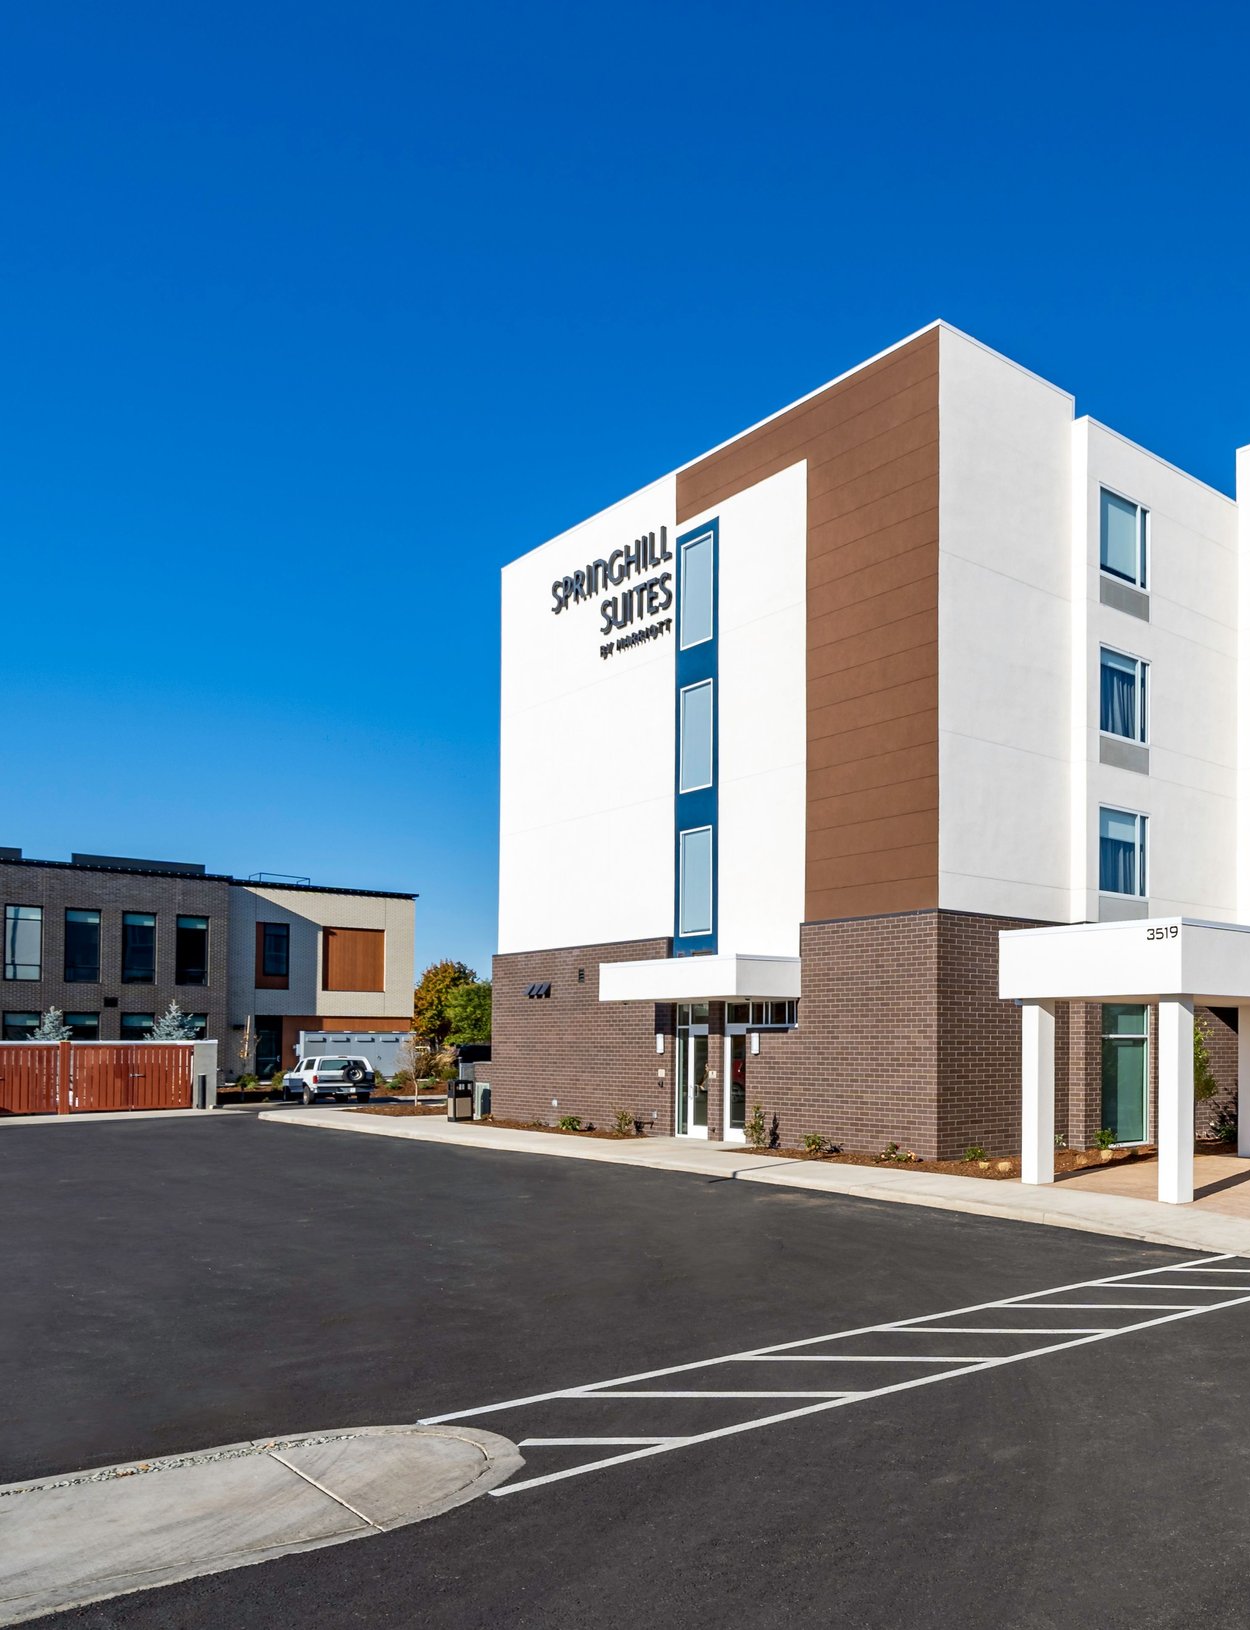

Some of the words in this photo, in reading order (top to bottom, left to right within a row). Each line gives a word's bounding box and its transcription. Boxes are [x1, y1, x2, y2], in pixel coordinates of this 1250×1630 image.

[551, 525, 673, 615] SPRINGHILL
[600, 571, 673, 635] SUITES
[600, 641, 615, 660] BY
[616, 618, 673, 654] MARRIOTT
[1146, 925, 1179, 941] 3519
